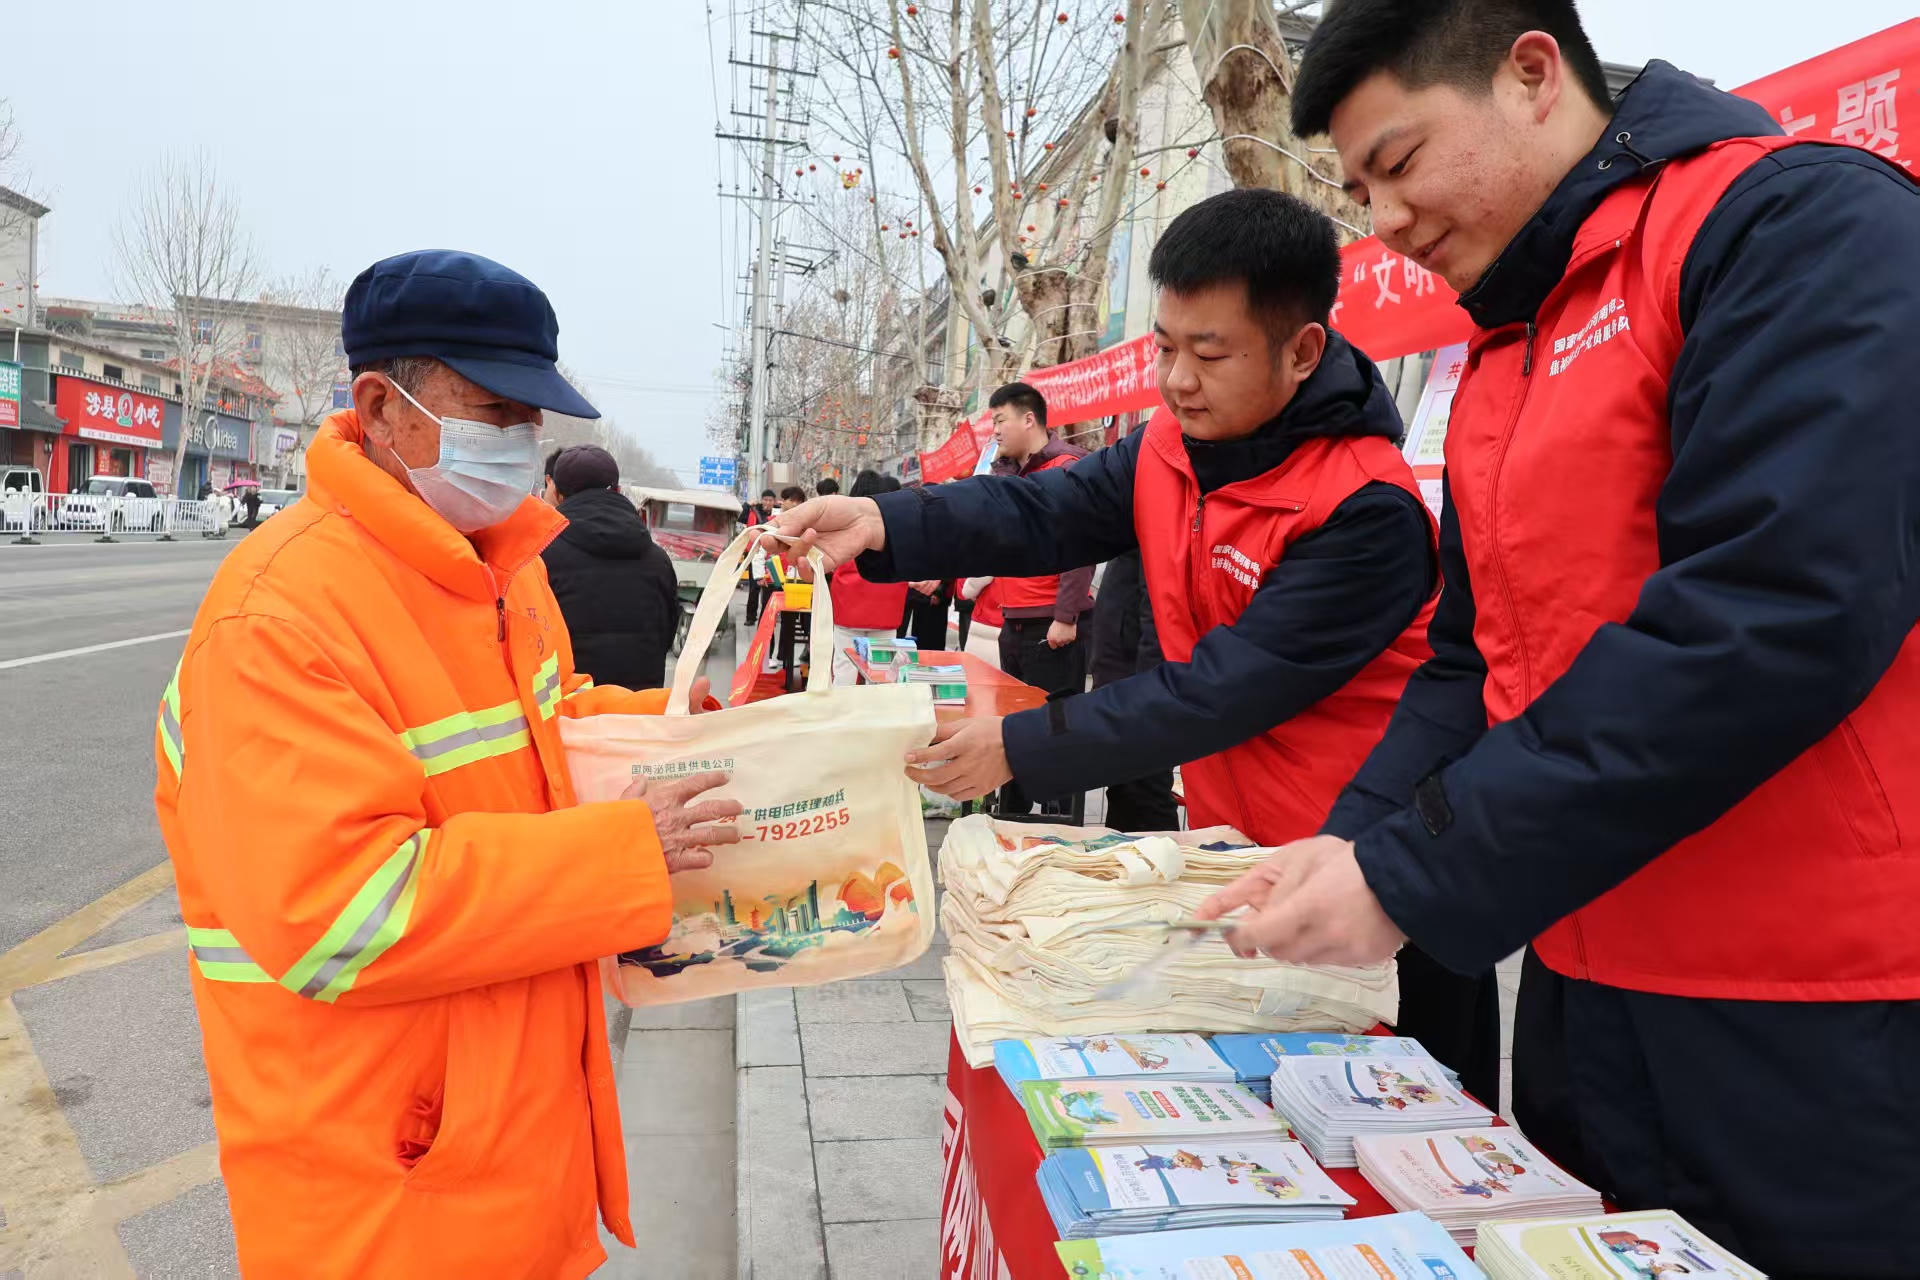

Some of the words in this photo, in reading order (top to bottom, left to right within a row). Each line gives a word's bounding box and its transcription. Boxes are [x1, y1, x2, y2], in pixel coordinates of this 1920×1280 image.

[86, 391, 116, 420] 沙县
[134, 402, 160, 429] 小吃
[754, 787, 845, 821] 供电总经理热线
